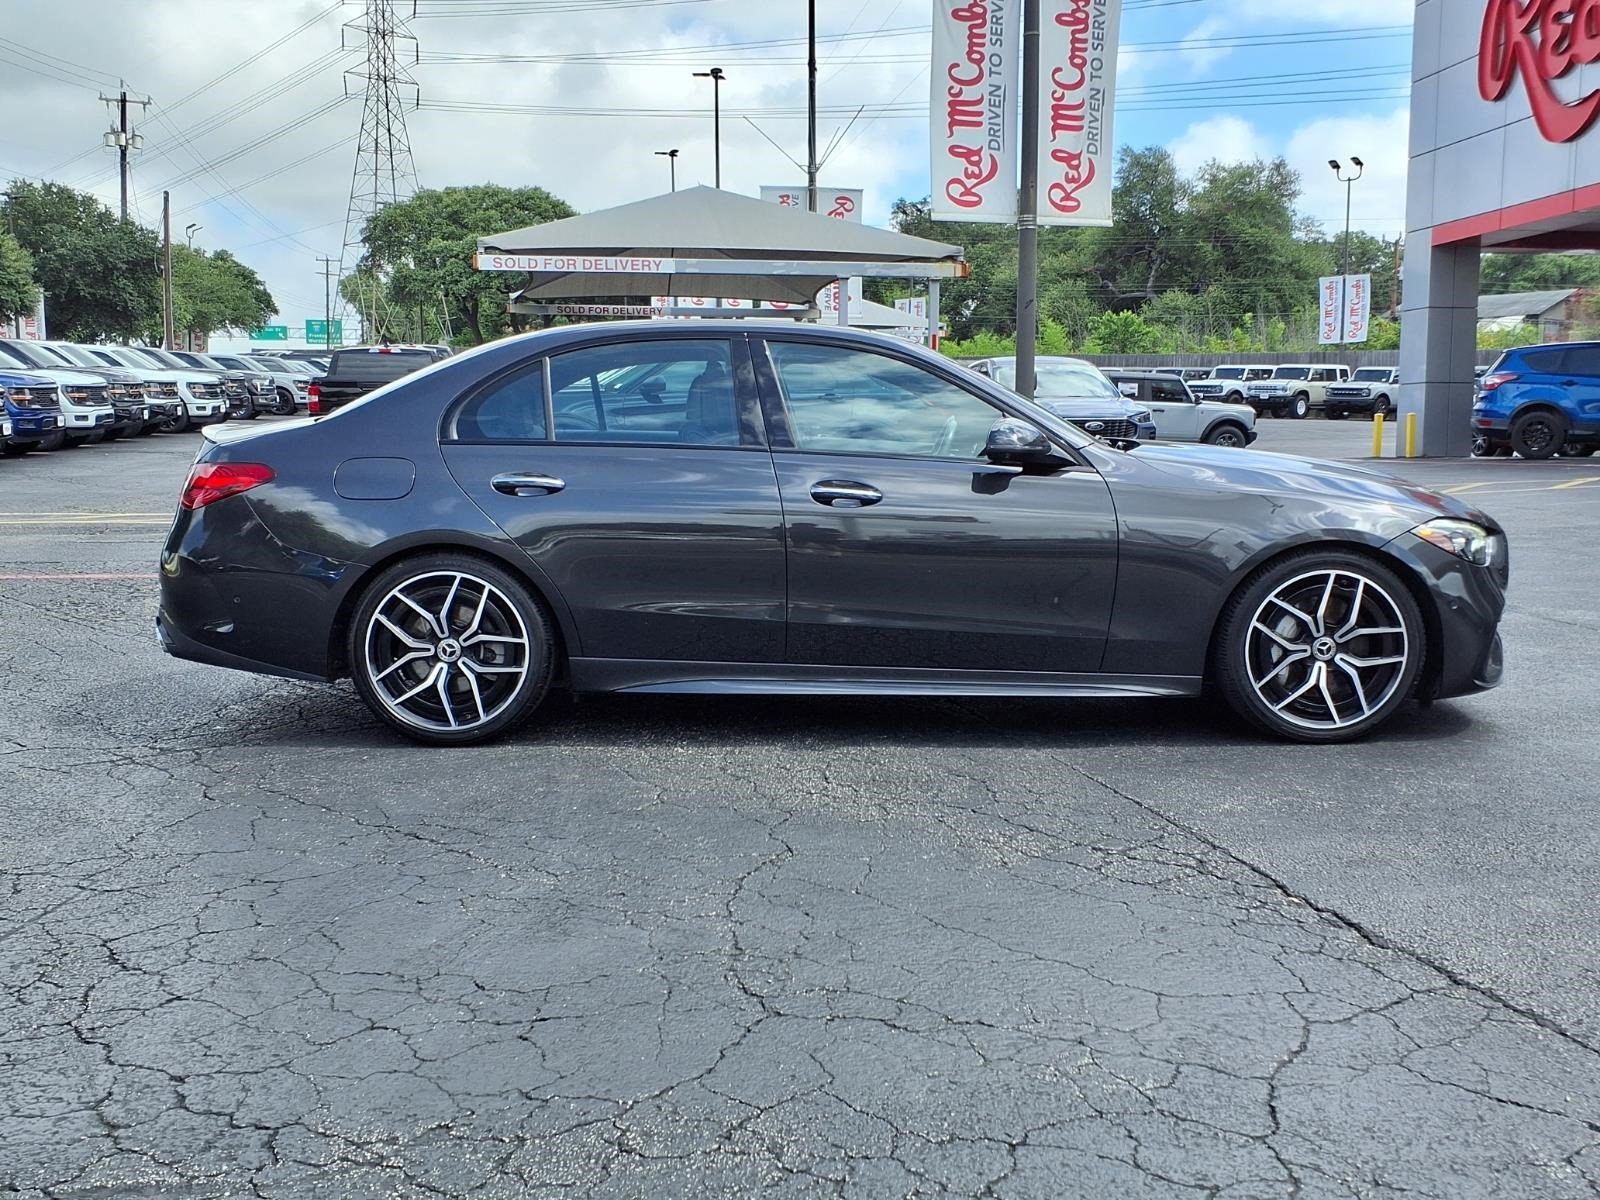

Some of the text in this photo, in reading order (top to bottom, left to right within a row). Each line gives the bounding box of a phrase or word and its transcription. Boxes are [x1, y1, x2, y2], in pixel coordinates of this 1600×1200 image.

[946, 0, 998, 208] Red McComb
[988, 0, 1005, 152] DRIVEN TO SERV
[1087, 0, 1107, 155] DRIVEN TO SERVE
[1048, 149, 1095, 213] Red
[493, 257, 663, 271] SOLD FOR DELIVERY
[557, 305, 663, 315] SOLD FOR DELIVERY
[824, 285, 832, 311] ERVE
